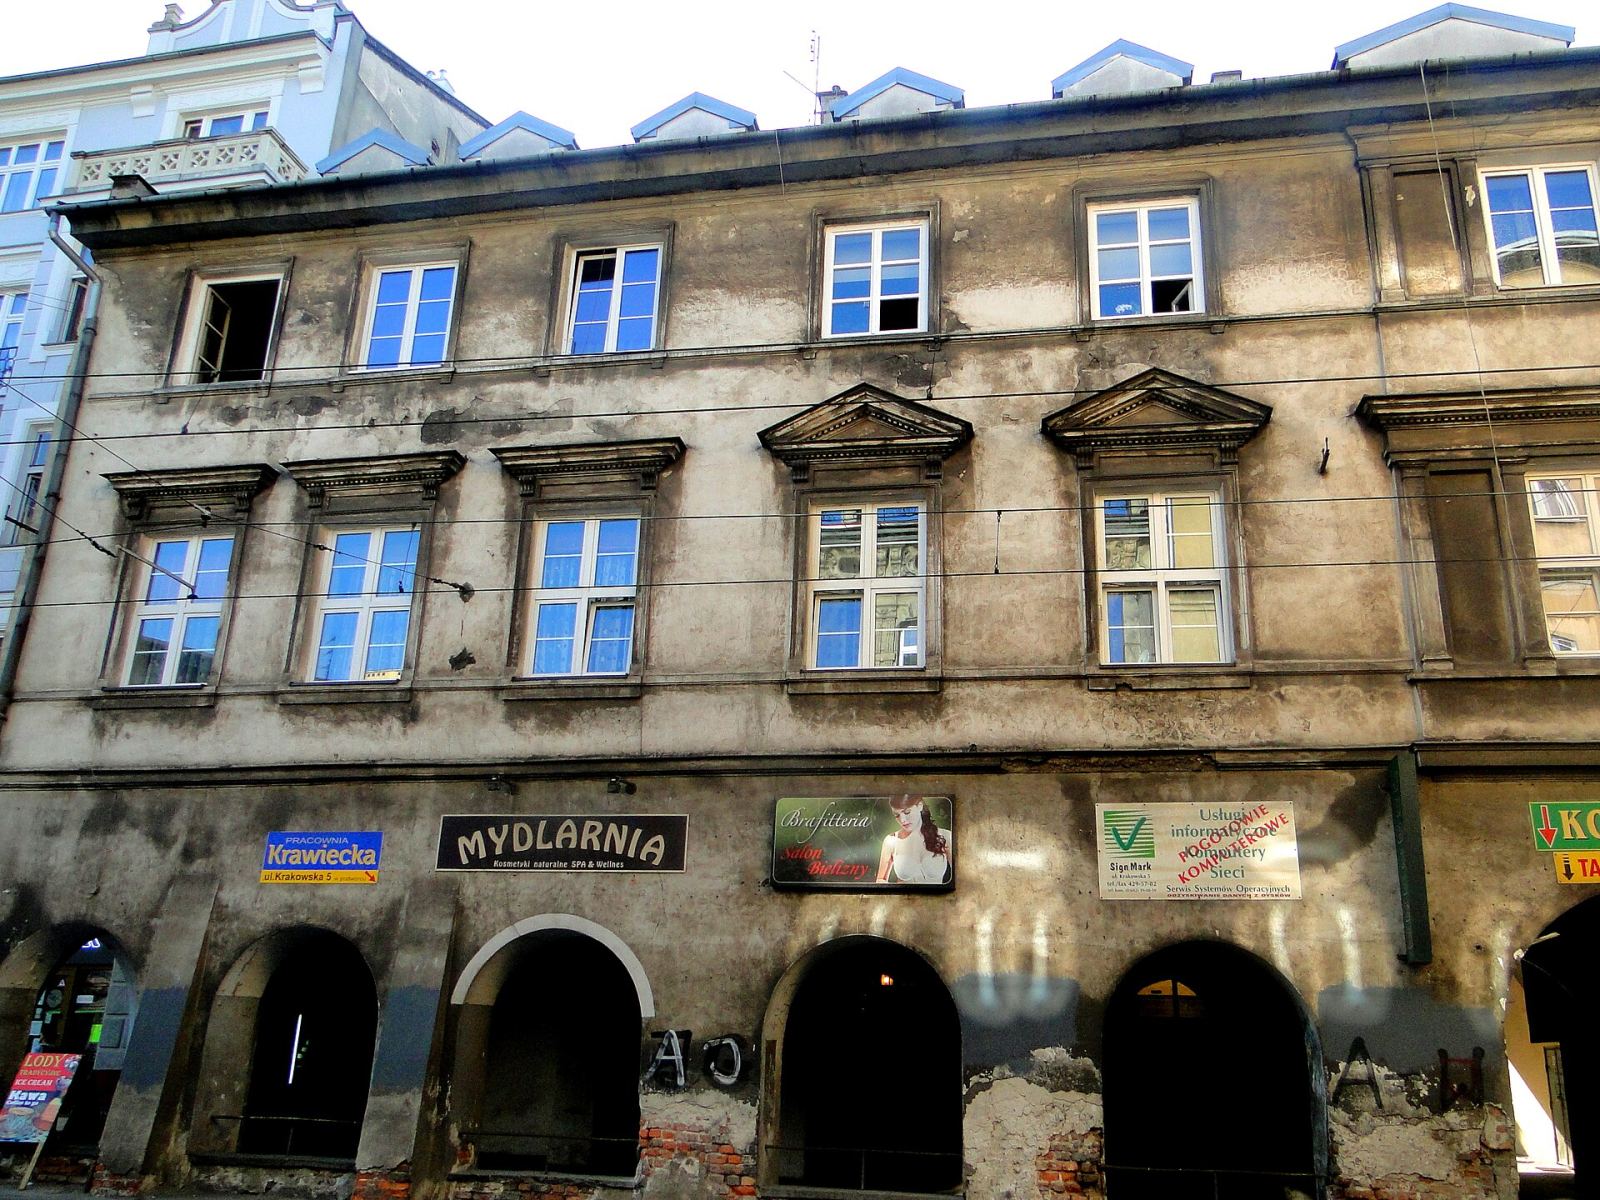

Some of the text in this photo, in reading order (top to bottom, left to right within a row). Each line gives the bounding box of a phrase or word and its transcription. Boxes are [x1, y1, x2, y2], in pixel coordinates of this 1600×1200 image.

[781, 802, 872, 843] Brafitteria
[1178, 804, 1269, 862] POGOTOWIE
[457, 818, 665, 866] MYDLARNIA
[1178, 813, 1289, 884] KOMPUTEROWE
[267, 844, 376, 865] Krawiecka
[533, 860, 568, 868] naturalne
[571, 860, 586, 868] SPA
[587, 860, 594, 868] &
[808, 858, 870, 880] Bielizny
[1110, 862, 1152, 873] Sign Mark
[326, 872, 332, 881] 5
[1210, 865, 1245, 879] Sieci
[1166, 884, 1191, 893] Serwis
[1194, 884, 1232, 894] Systemów
[1235, 884, 1290, 894] Operacyjnych
[24, 1054, 66, 1068] LODY
[8, 1090, 47, 1101] Kawa
